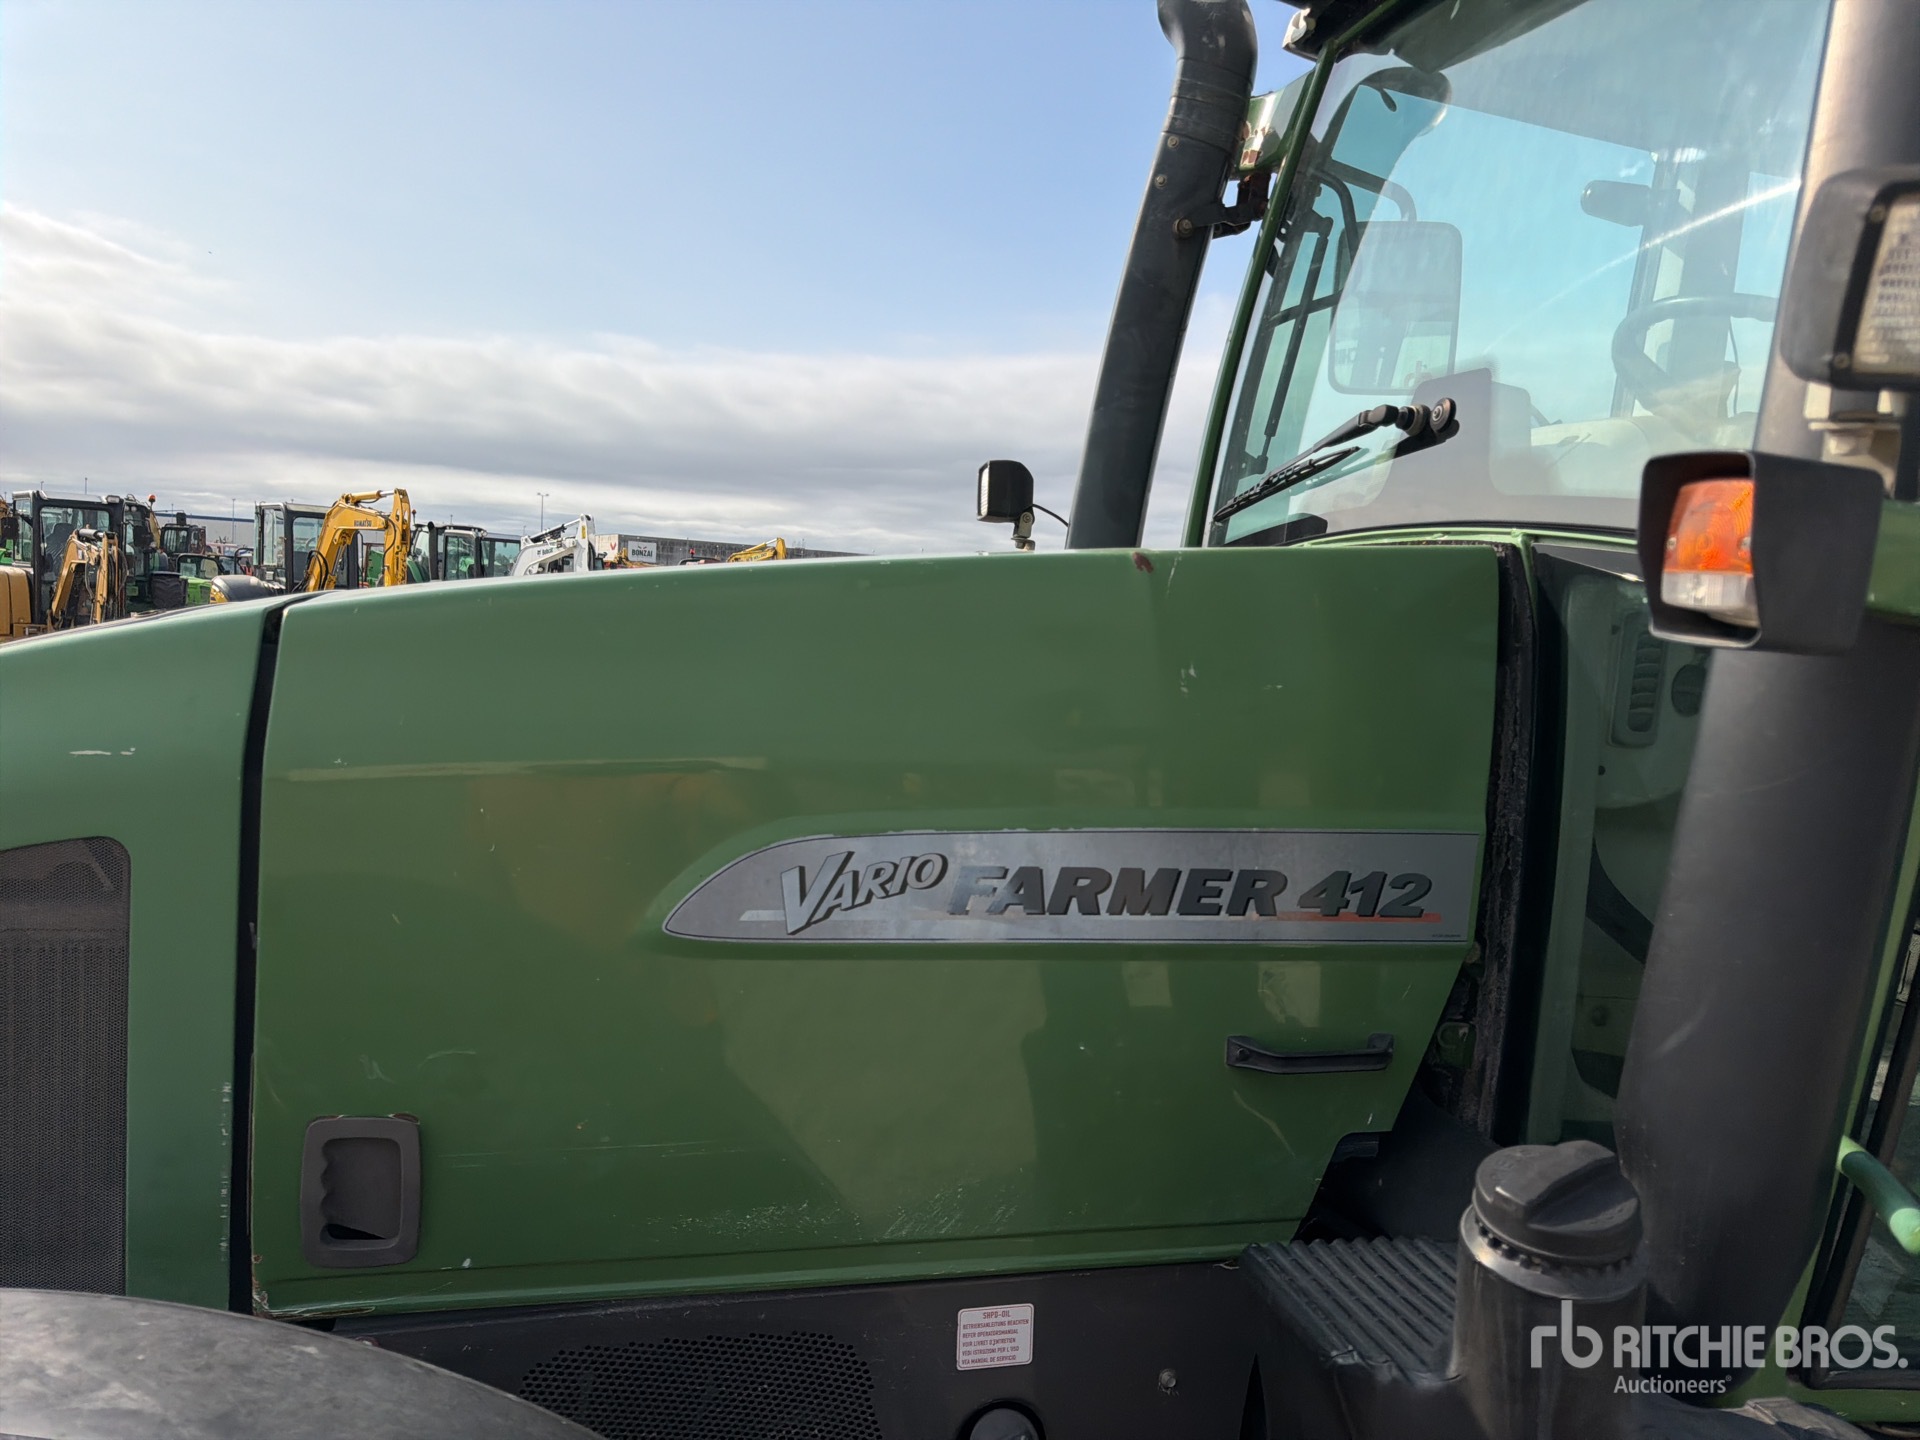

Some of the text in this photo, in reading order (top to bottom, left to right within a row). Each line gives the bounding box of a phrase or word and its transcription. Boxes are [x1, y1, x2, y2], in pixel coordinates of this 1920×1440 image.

[631, 549, 653, 557] BONZAI
[780, 851, 1433, 935] VARIO FARMER 412
[983, 1310, 1011, 1319] SHPD-OIL
